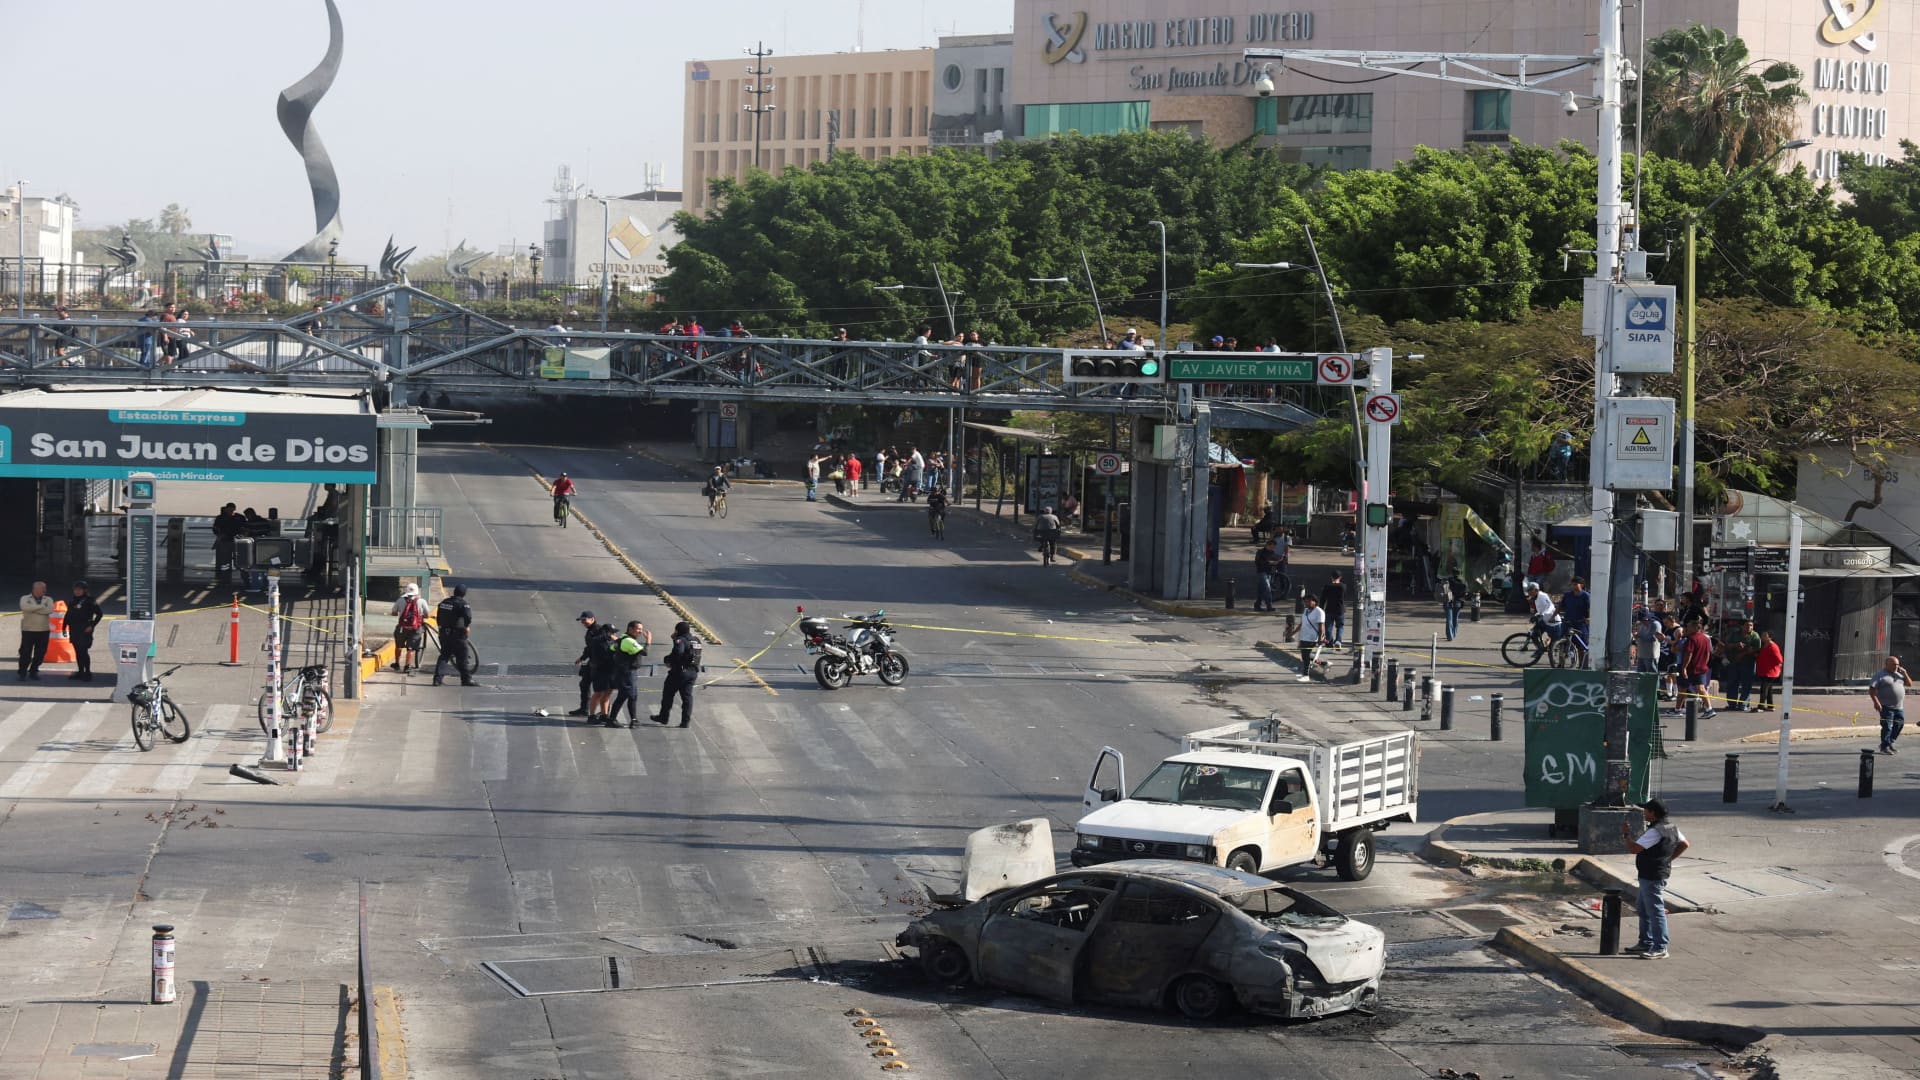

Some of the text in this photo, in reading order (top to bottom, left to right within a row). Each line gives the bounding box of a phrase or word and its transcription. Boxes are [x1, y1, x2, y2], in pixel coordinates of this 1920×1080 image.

[1094, 11, 1315, 50] MAGNO CENTRO JOYERO
[1129, 65, 1162, 89] San
[1168, 65, 1206, 91] Juan
[1208, 62, 1228, 88] de
[1817, 58, 1889, 93] MAGNO
[1631, 310, 1660, 320] agua
[1628, 332, 1662, 342] SIAPA
[1181, 364, 1302, 376] AV. JAVIER MINA
[118, 410, 236, 423] Estación Express
[30, 432, 369, 463] San Juan de Dios
[1103, 458, 1114, 467] 50
[180, 472, 225, 480] Mirador
